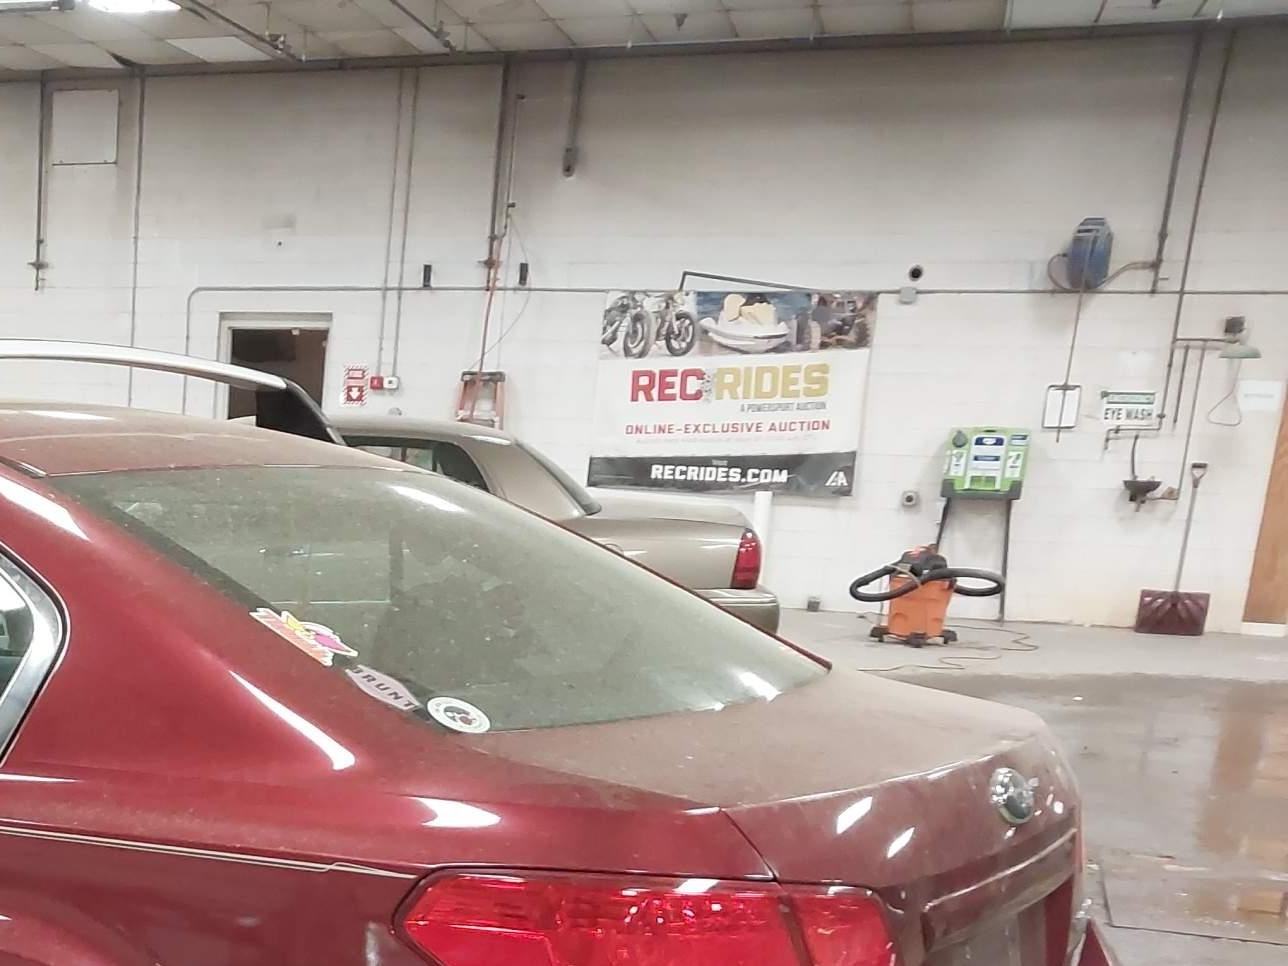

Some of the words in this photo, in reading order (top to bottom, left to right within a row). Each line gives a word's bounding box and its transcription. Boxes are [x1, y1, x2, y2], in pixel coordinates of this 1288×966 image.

[631, 369, 704, 401] REC
[715, 364, 829, 400] RIDES
[1104, 407, 1123, 420] EYE
[626, 423, 763, 435] ONLINE-EXCLUSIVE
[769, 420, 830, 432] AUCTION
[651, 465, 788, 483] RECRIDES.COM
